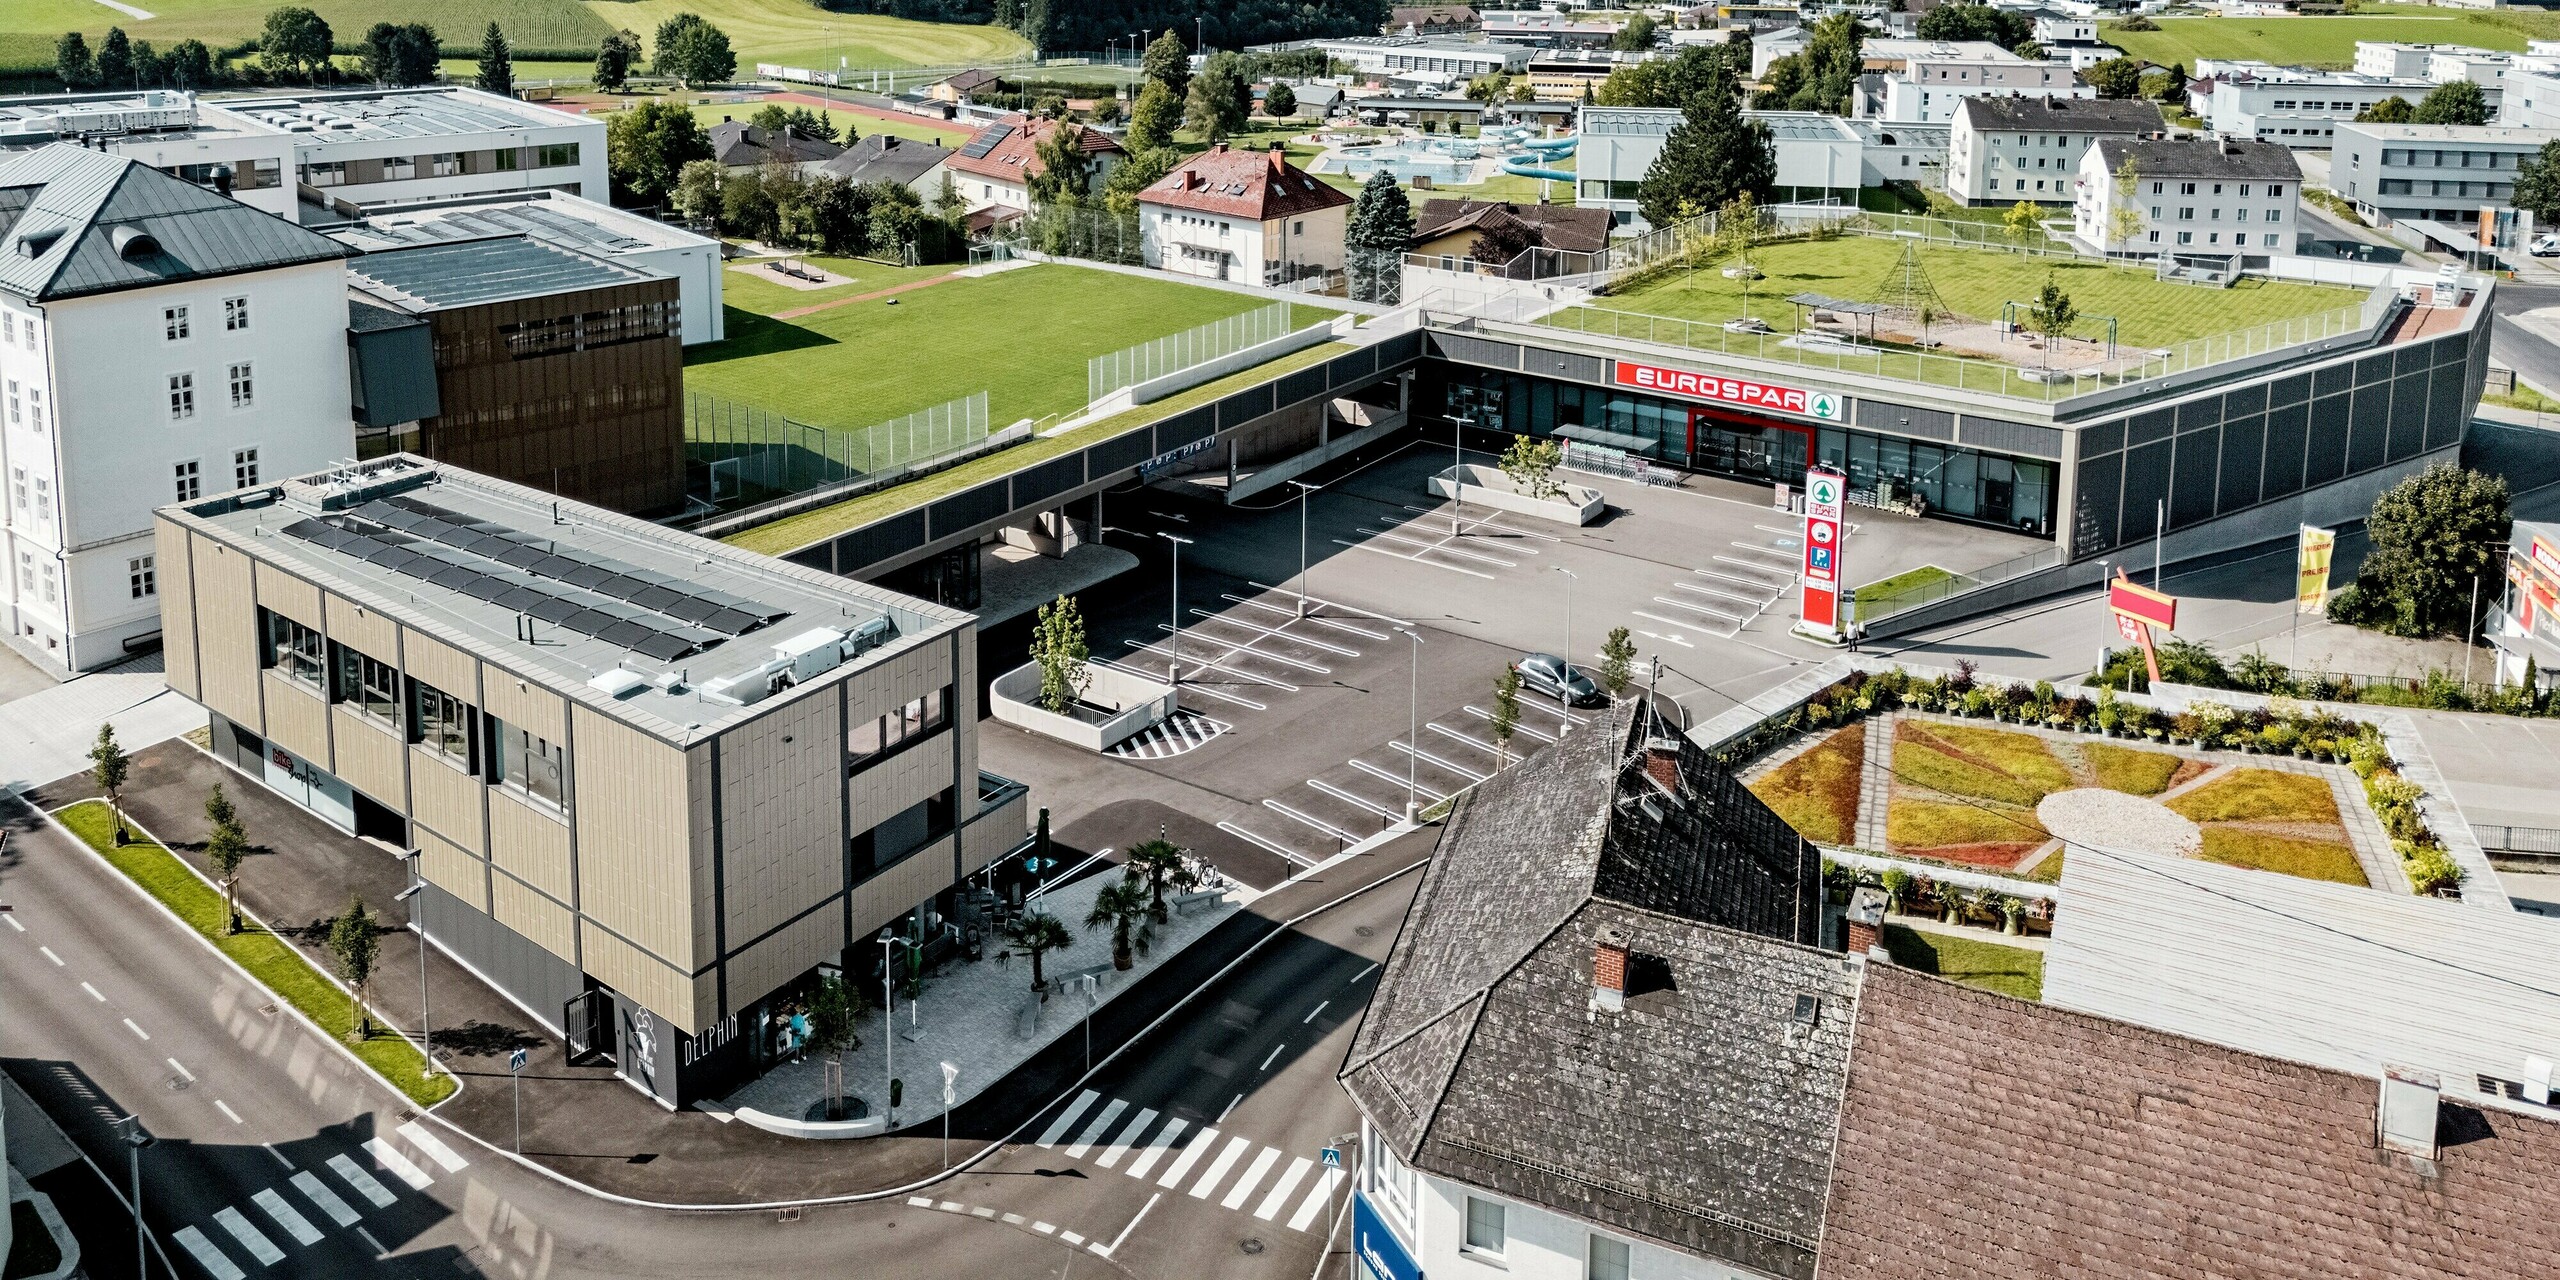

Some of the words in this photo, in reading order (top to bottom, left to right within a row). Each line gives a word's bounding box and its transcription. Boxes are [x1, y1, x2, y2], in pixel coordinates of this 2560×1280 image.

[1636, 367, 1804, 410] EUROSPAR
[1816, 549, 1826, 561] P
[2301, 566, 2329, 578] PREISE
[273, 748, 292, 768] bike
[684, 1011, 738, 1067] DELPHIN
